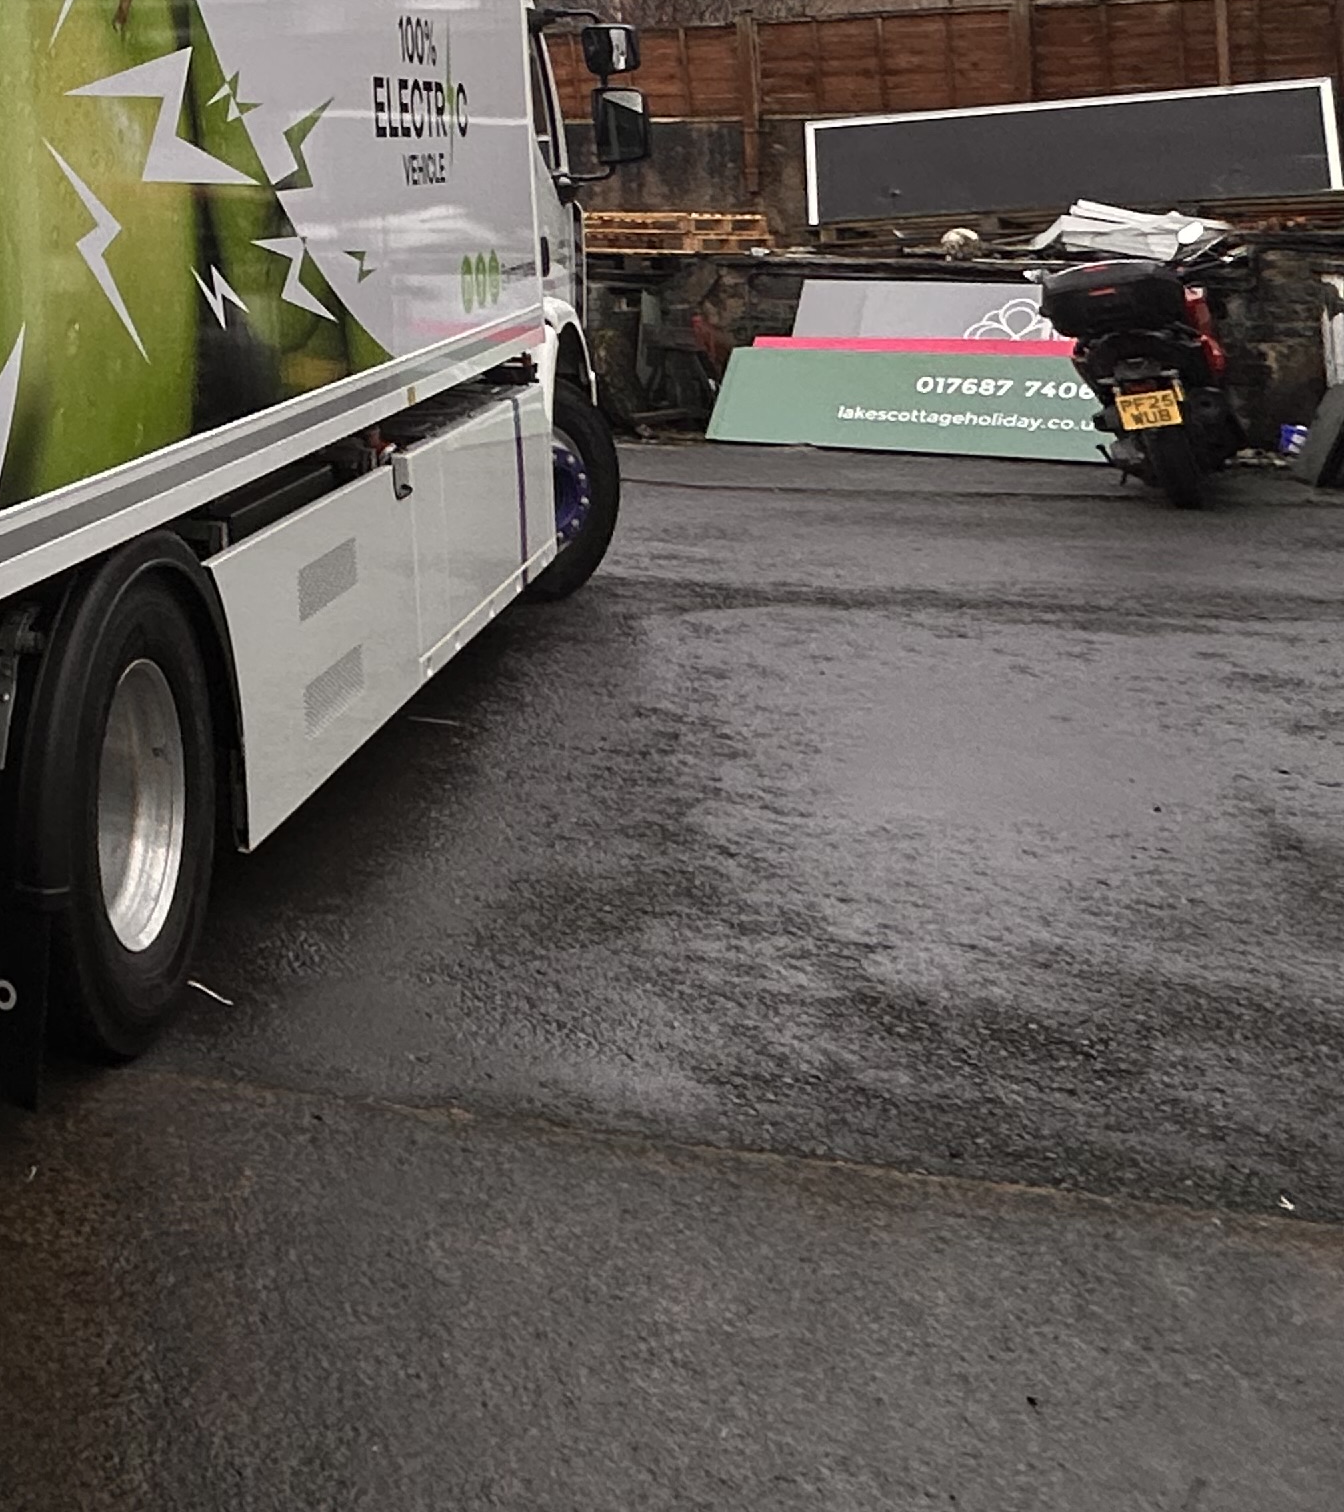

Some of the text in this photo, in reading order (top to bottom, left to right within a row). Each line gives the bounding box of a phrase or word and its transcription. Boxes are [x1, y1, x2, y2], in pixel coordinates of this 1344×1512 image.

[398, 15, 437, 66] 100%
[402, 153, 445, 186] VEHICLE
[915, 375, 1095, 400] 017687 7406
[1120, 394, 1173, 413] PF25
[837, 405, 1095, 431] lakescottageholiday.co.u
[1131, 408, 1171, 426] WUB
